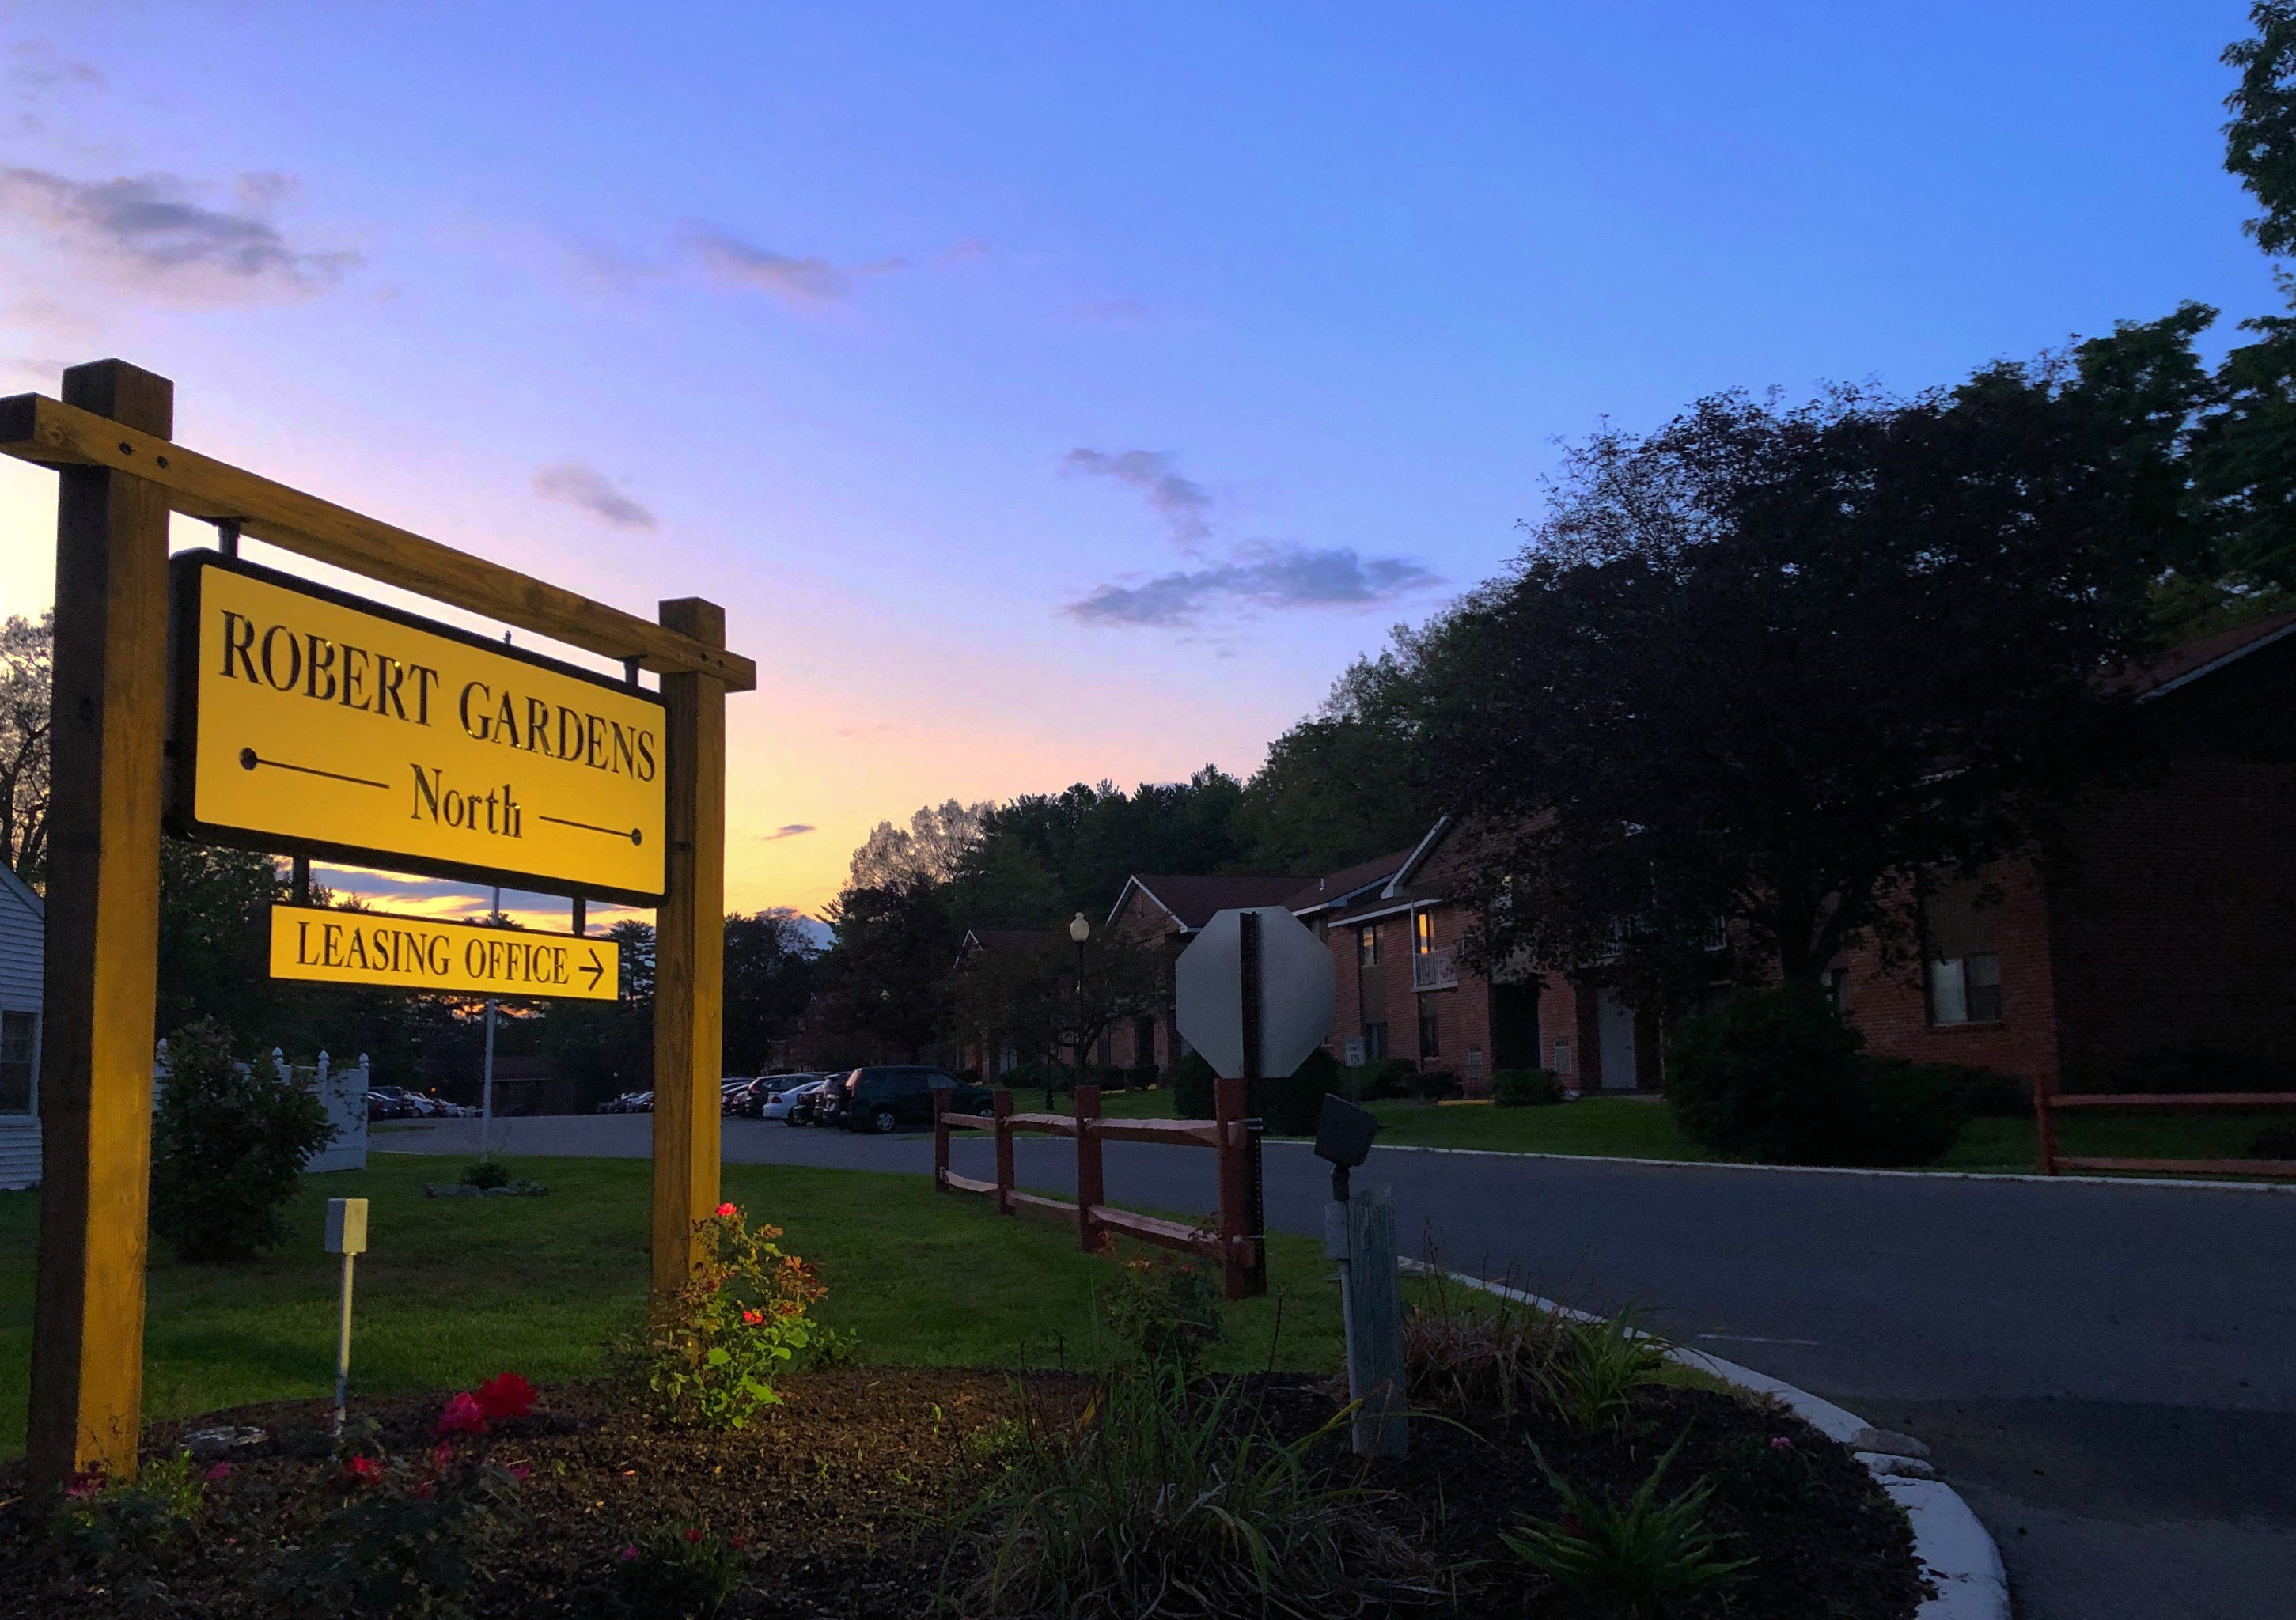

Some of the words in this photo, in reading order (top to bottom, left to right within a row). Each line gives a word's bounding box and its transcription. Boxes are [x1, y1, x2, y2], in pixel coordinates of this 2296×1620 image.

[219, 610, 439, 727] ROBERT
[458, 681, 655, 782] GARDENS
[410, 763, 523, 838] North
[296, 921, 451, 977] LEASING
[464, 938, 569, 985] OFFICE
